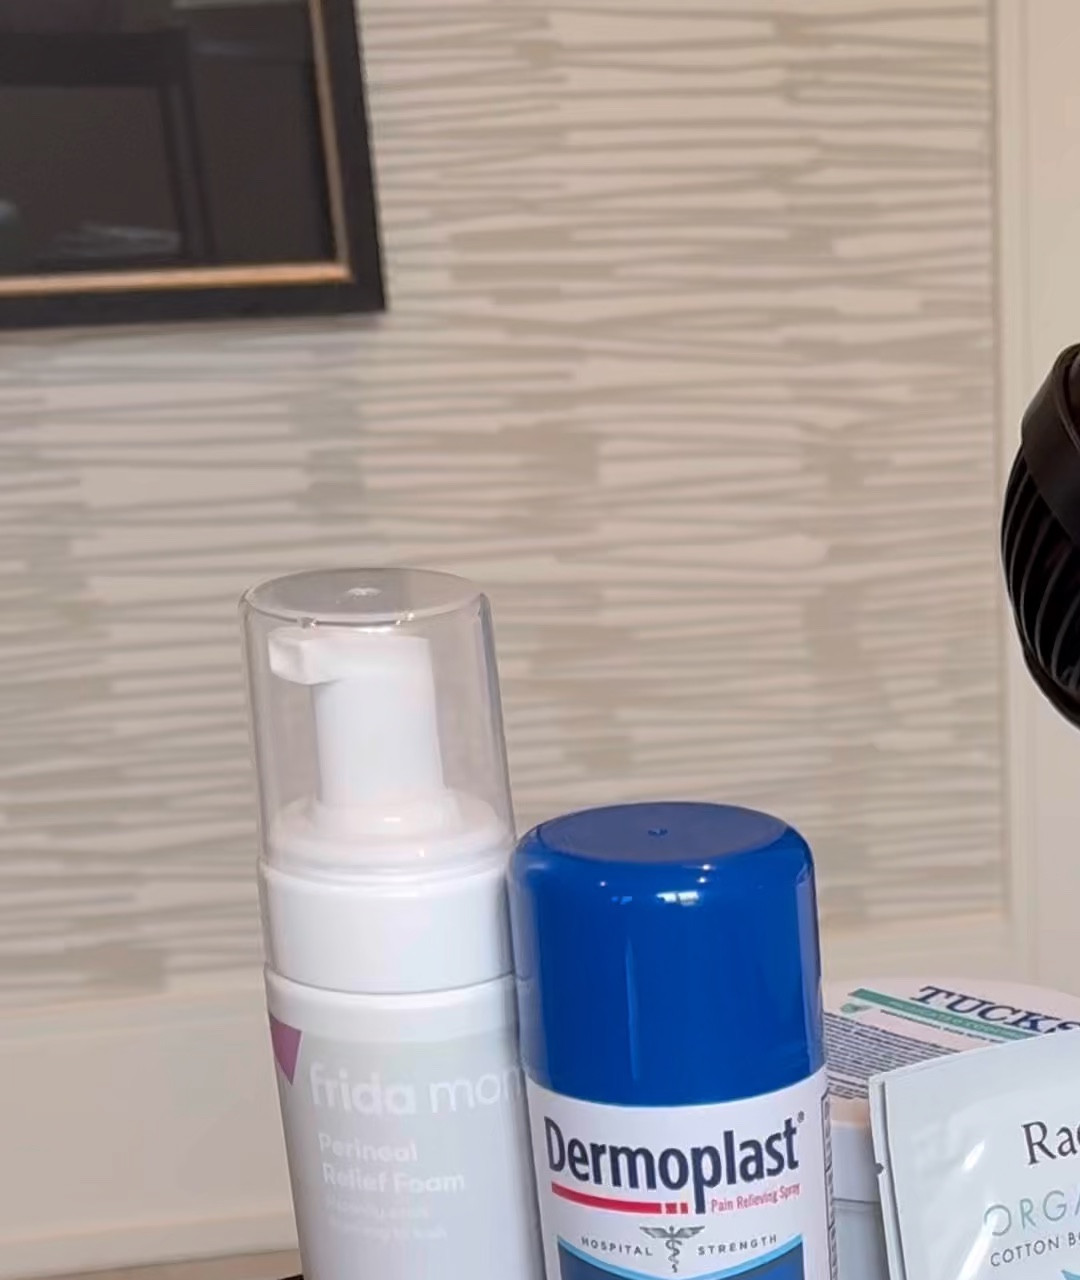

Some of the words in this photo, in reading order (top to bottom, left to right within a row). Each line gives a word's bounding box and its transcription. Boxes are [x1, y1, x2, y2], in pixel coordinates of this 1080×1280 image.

[310, 1062, 416, 1116] frida
[318, 1133, 417, 1163] Perineal
[322, 1163, 386, 1193] Relief
[395, 1170, 465, 1194] Foam
[544, 1116, 800, 1214] Dermoplast
[711, 1198, 734, 1213] Pain
[736, 1192, 778, 1210] Relieving
[778, 1182, 800, 1201] Spray
[581, 1236, 654, 1257] HOSPITAL
[697, 1233, 778, 1256] STRENGTH
[990, 1234, 1060, 1267] COTTON
